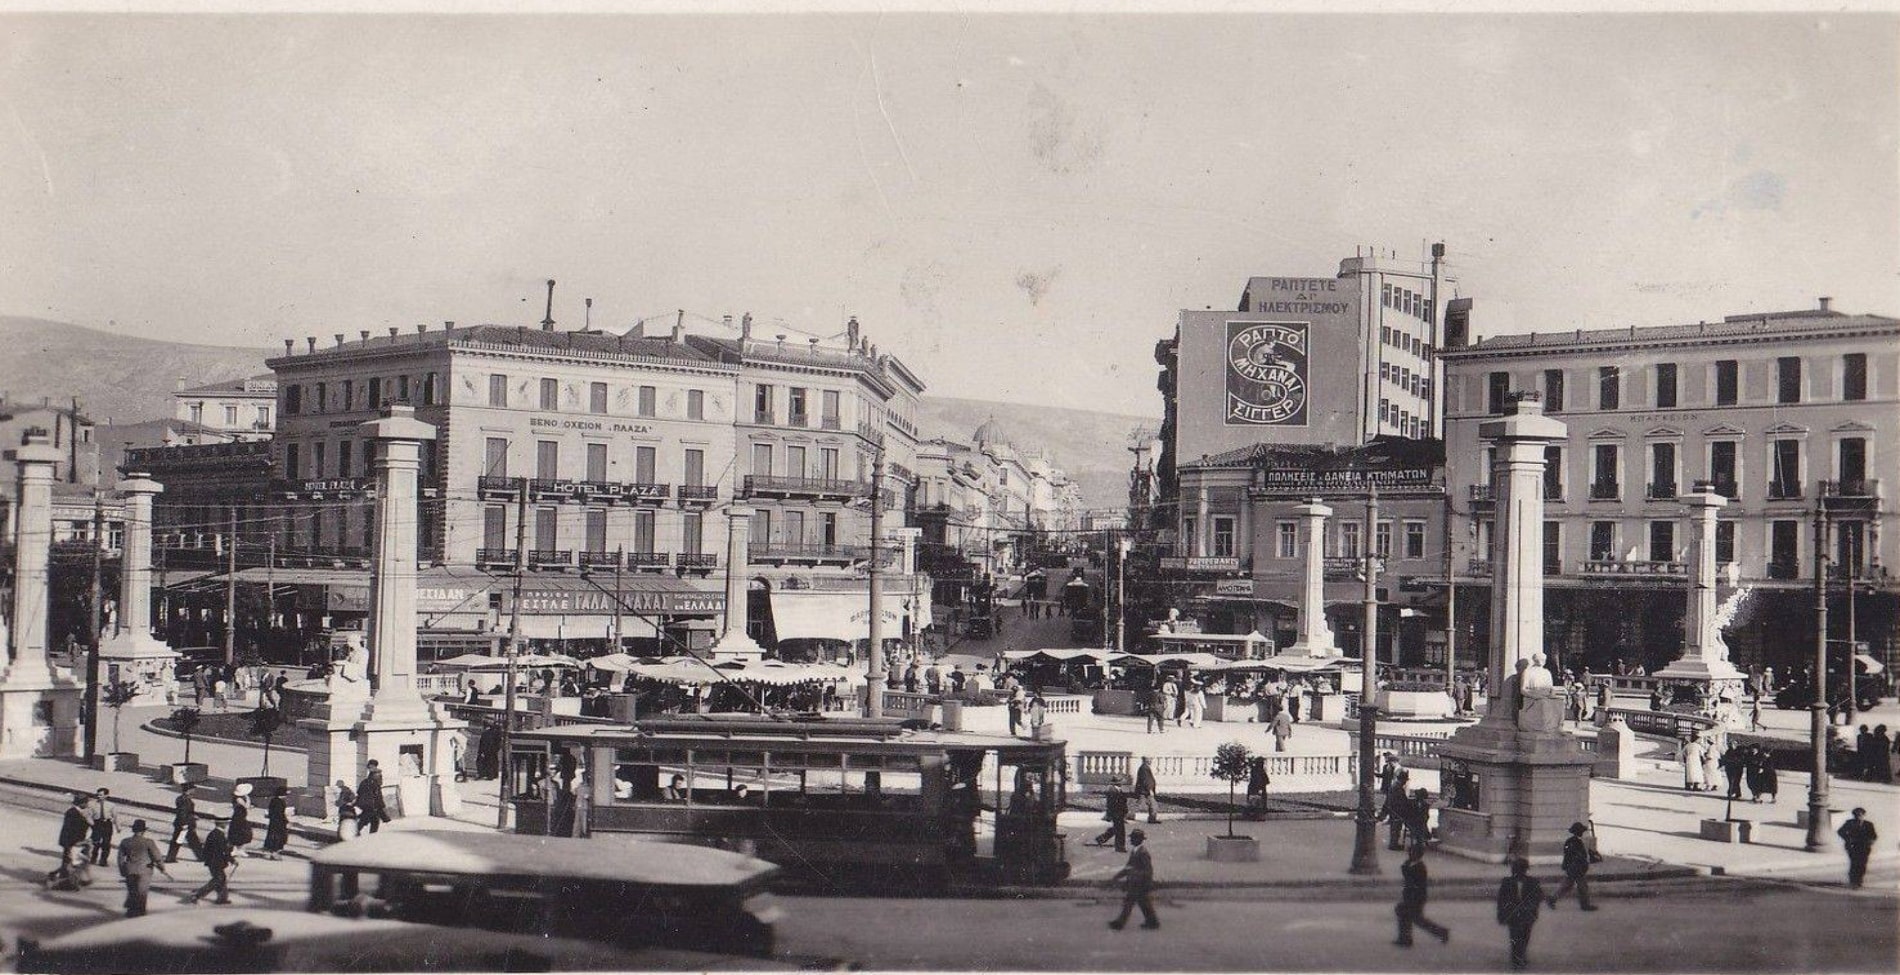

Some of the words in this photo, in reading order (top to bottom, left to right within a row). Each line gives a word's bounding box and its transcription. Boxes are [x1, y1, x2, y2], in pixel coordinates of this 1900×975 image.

[1271, 279, 1337, 291] ΡΑΠΤΕΤΕ
[1258, 301, 1349, 314] ΗΛΕΚΤΡΙΣΜΟΥ
[1239, 328, 1300, 348] ΡΑΠΤΟ
[1234, 357, 1302, 392] ΜΗΧΑΝΑΙ
[1233, 399, 1294, 420] ΣΙΓΓΕΡ
[1324, 472, 1362, 481] ΔΑΝΕΙΑ
[1366, 468, 1427, 480] ΚΤΗΜΑΤΩΝ
[553, 483, 603, 494] HOTEL
[609, 486, 660, 496] PLAZA
